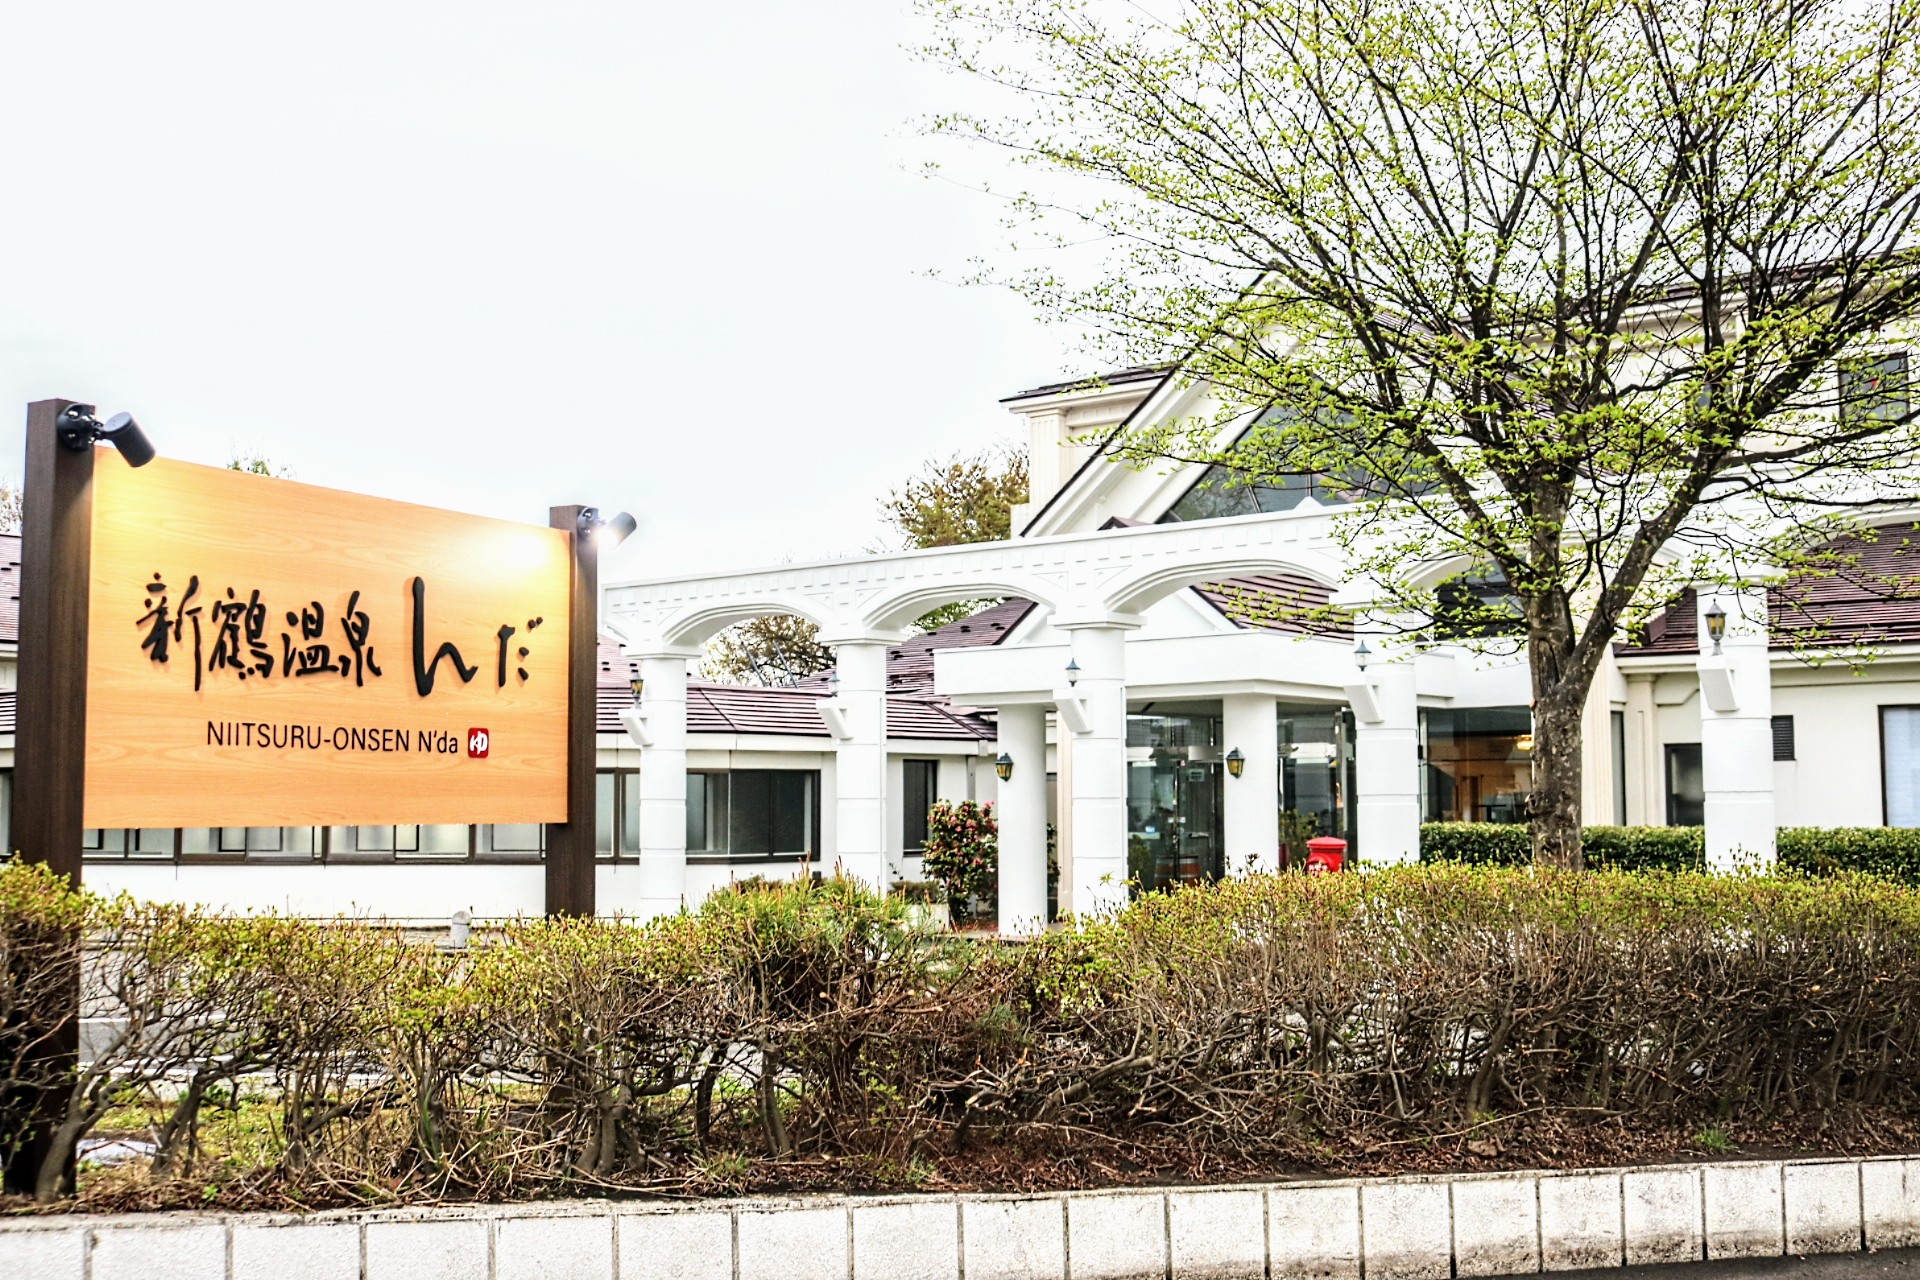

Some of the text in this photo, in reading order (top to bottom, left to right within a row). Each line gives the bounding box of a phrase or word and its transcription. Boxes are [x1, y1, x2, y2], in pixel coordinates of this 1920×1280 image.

[136, 572, 543, 697] 新鶴温泉 んだ
[207, 721, 410, 752] NIITSURU-ONSEN
[469, 730, 489, 755] ゆ
